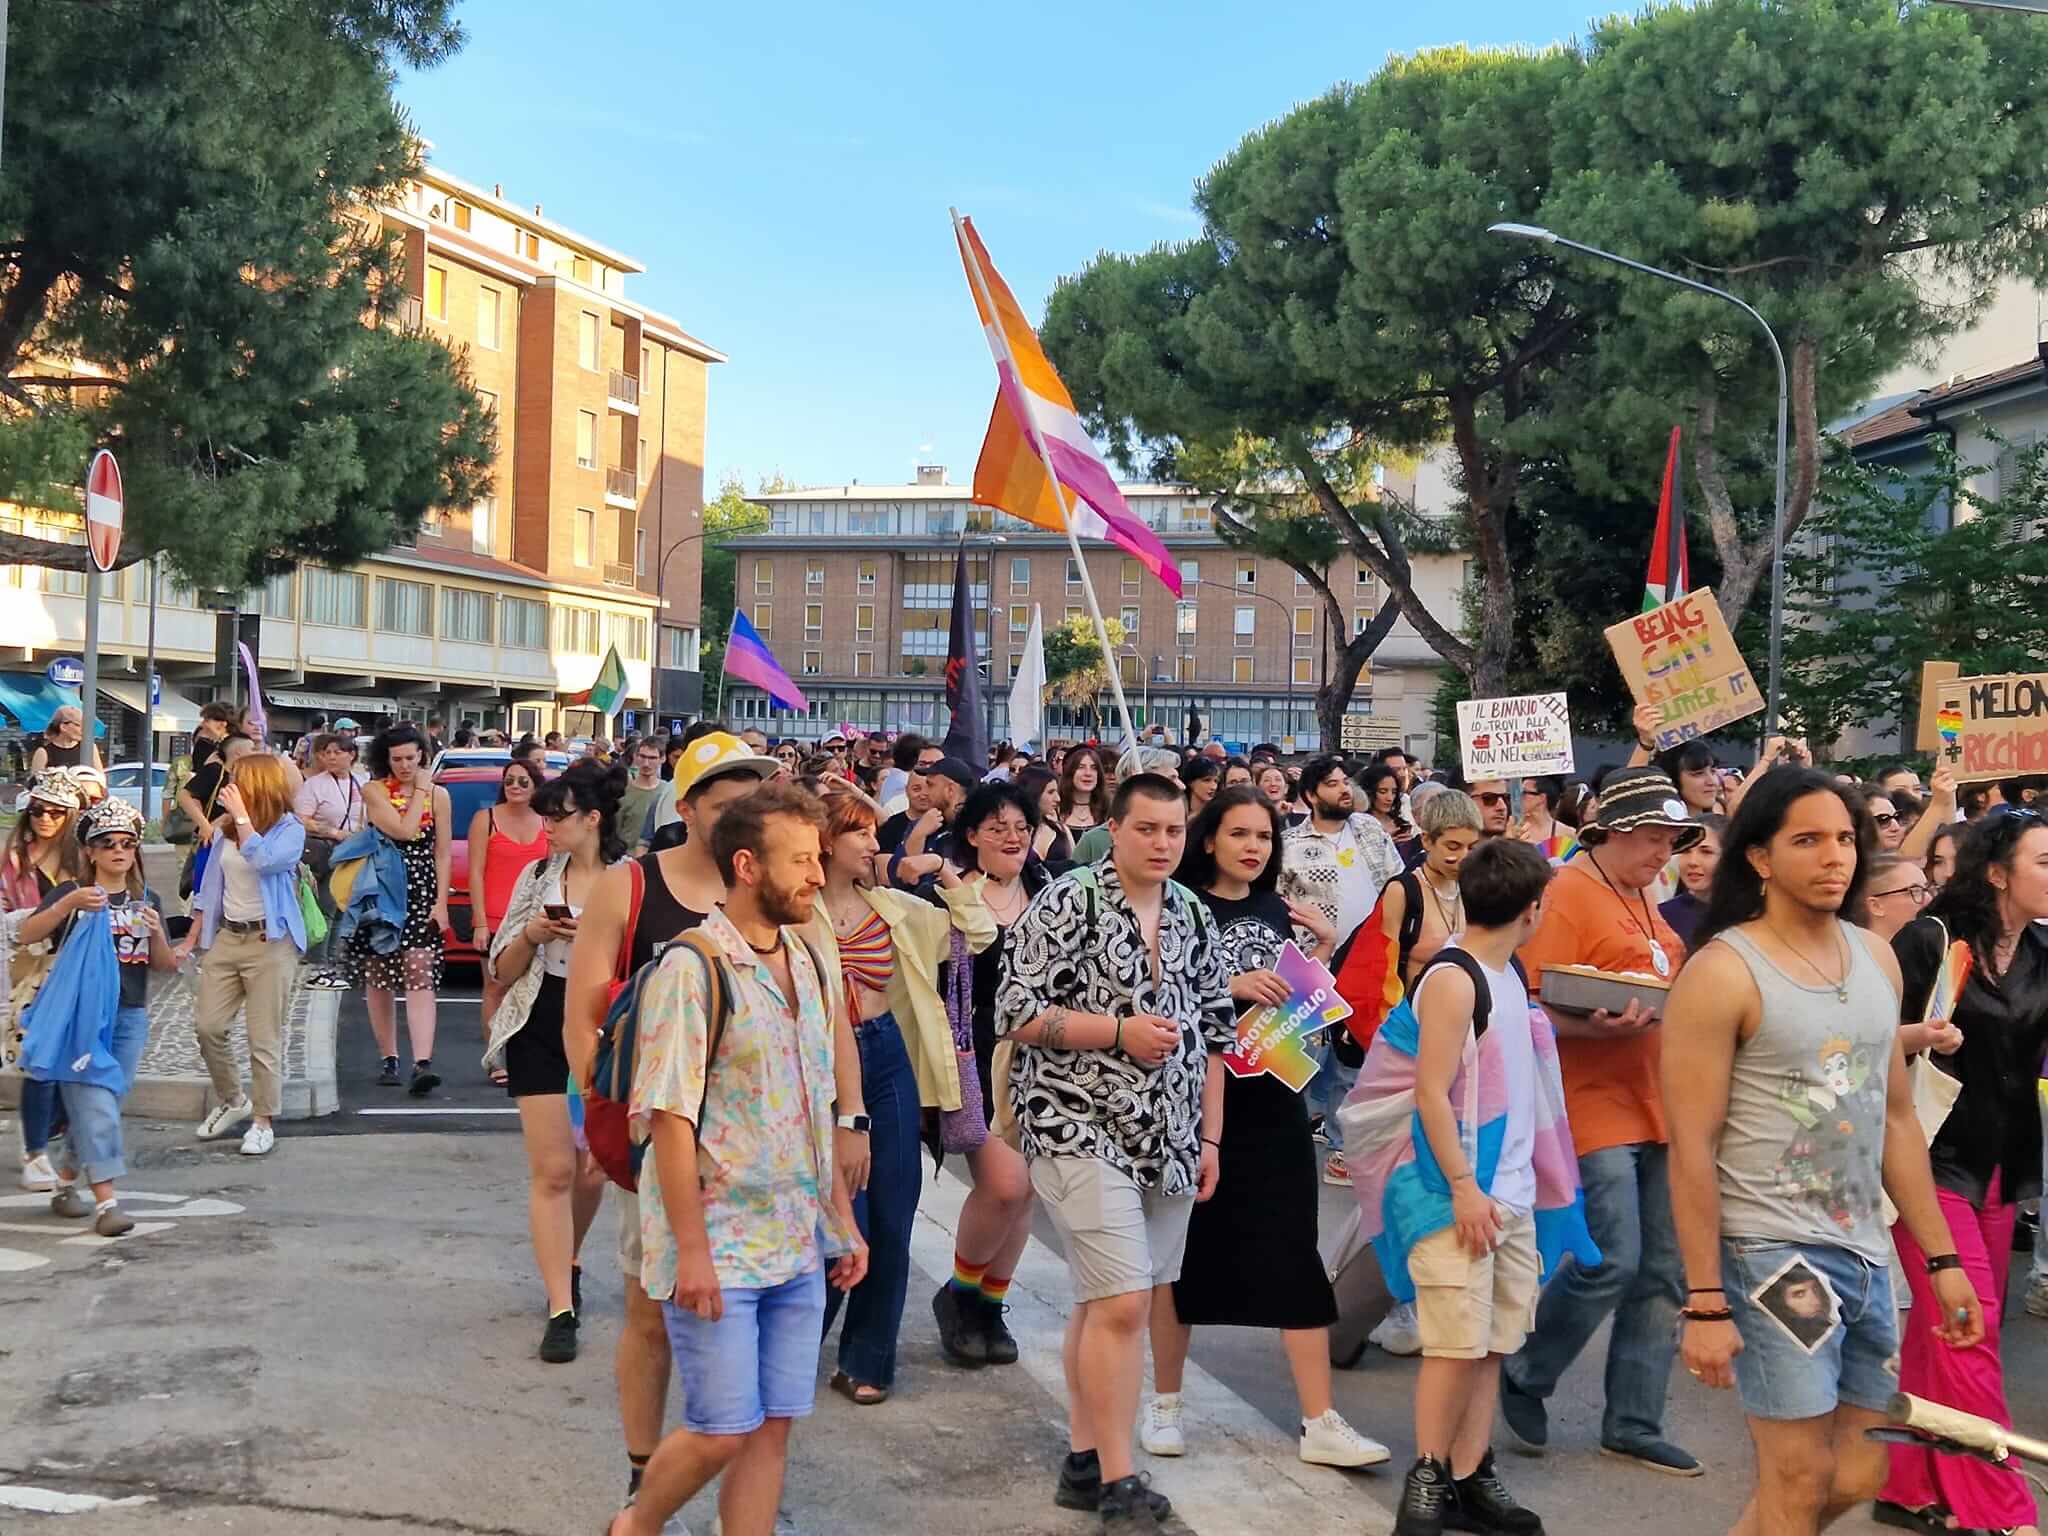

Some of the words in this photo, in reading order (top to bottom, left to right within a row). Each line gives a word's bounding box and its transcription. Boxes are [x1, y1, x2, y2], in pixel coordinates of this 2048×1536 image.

[1633, 597, 1704, 645] BEING
[1641, 624, 1712, 678] GAY
[1475, 703, 1486, 719] IL
[1491, 699, 1538, 718] BINARIO
[1969, 679, 2048, 720] MELON
[1488, 718, 1519, 733] TROVI
[1526, 715, 1551, 729] ALLA
[1470, 748, 1498, 765] NON
[1501, 745, 1520, 762] NEL
[1261, 987, 1328, 1051] ORGOGLIO
